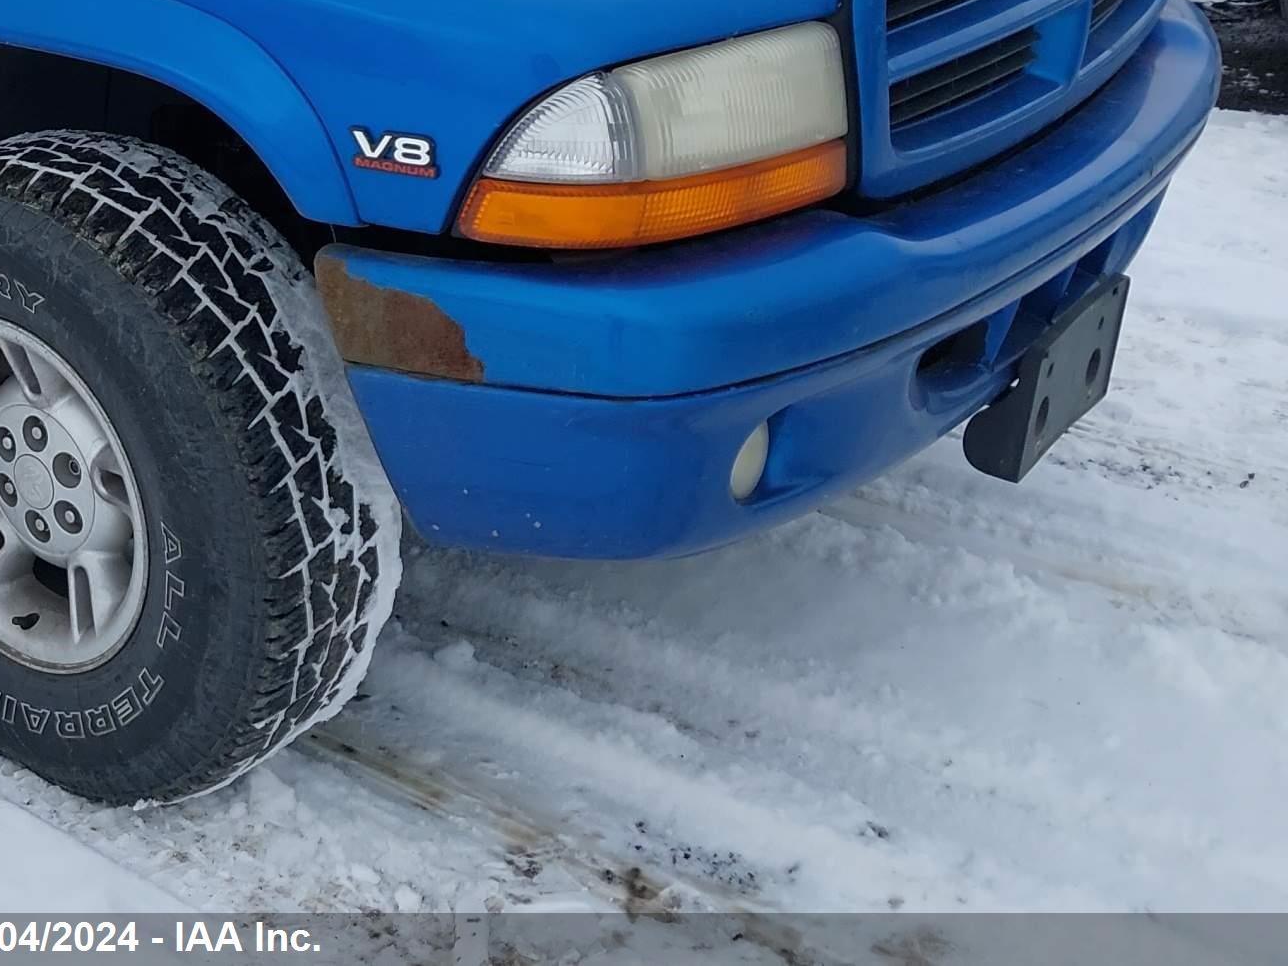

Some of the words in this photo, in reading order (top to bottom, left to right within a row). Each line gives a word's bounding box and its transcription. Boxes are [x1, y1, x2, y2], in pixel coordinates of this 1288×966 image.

[352, 130, 431, 166] V8
[354, 158, 436, 178] MAGNUM
[157, 521, 186, 649] ALL
